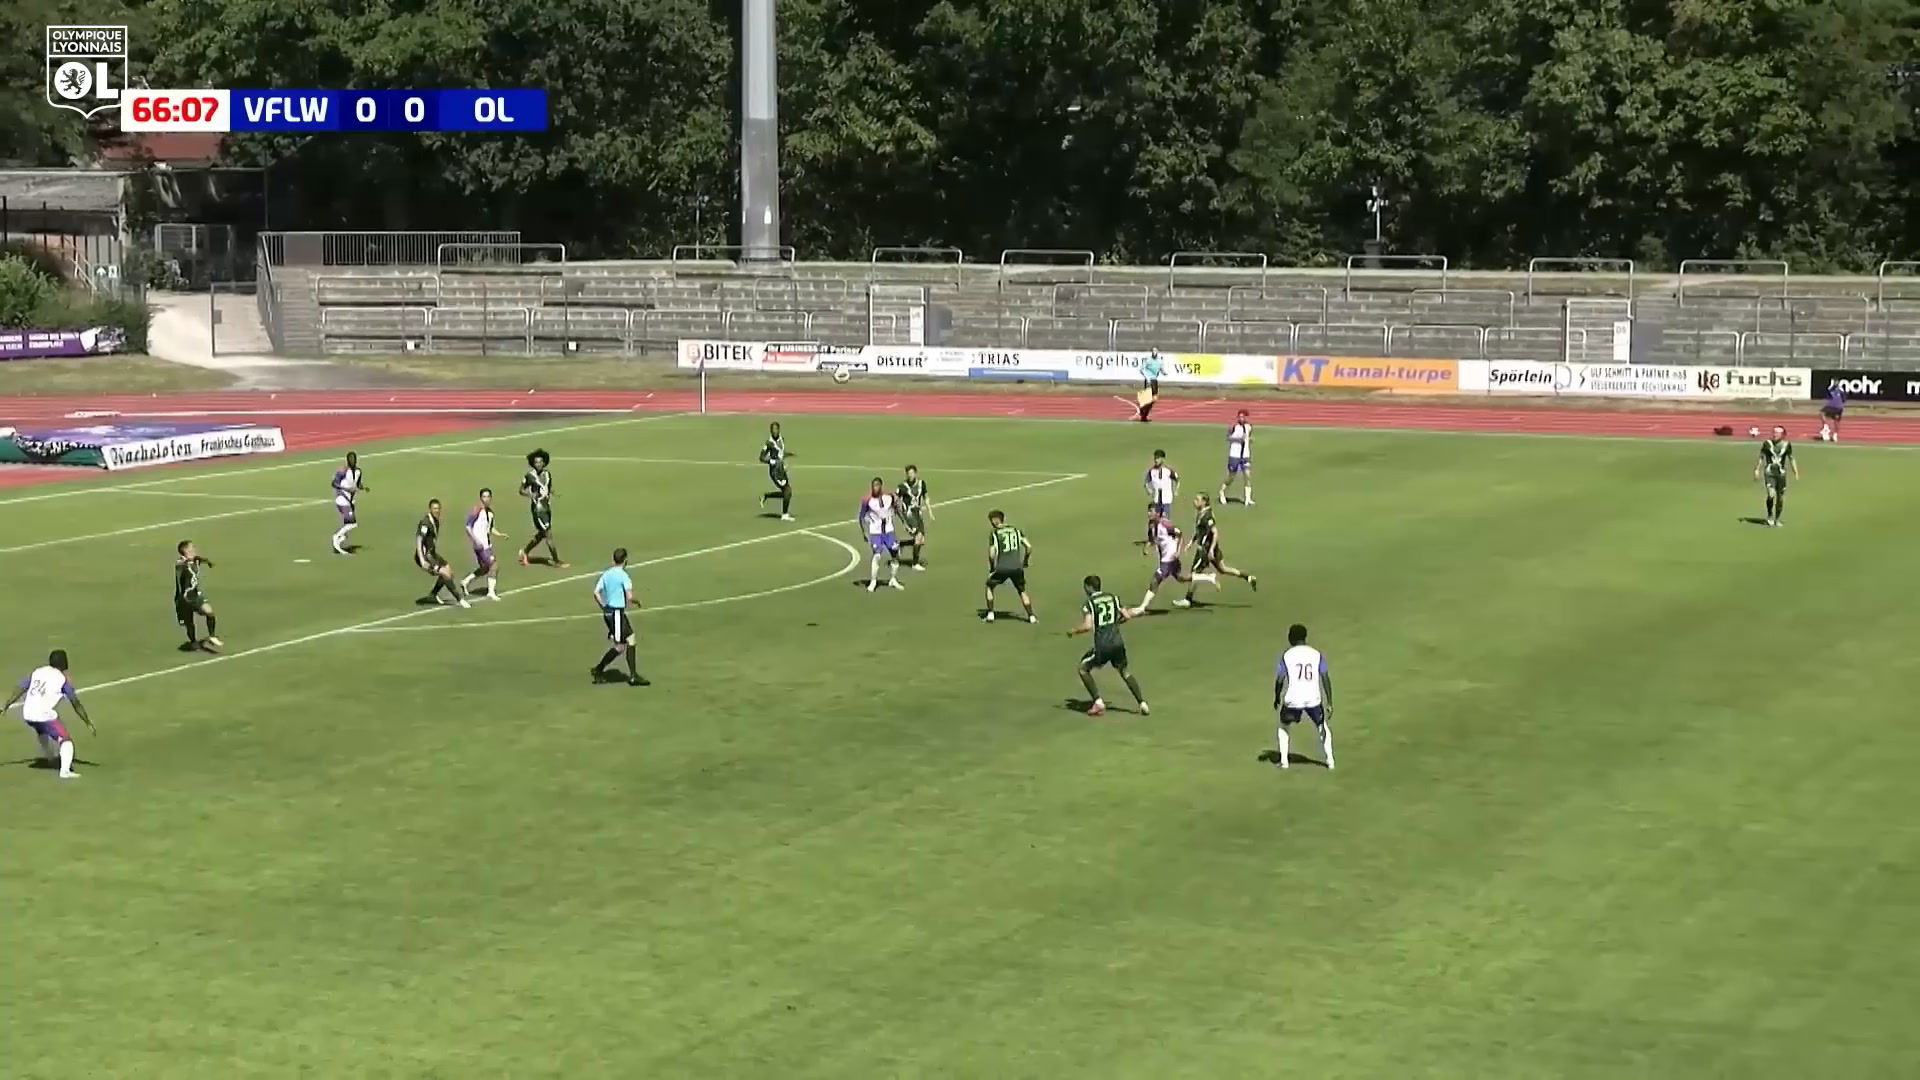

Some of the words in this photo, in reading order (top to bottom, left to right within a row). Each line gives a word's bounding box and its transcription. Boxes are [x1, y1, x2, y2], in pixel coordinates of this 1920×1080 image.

[704, 343, 753, 361] BITEK
[978, 351, 1021, 367] TRIAS
[877, 355, 923, 368] DISTLER
[1282, 357, 1330, 383] KT
[1333, 363, 1453, 384] kanal-turpe
[1489, 368, 1553, 386] Spörlein
[1604, 367, 1632, 379] SCHMITT
[1641, 368, 1670, 380] PARTNER
[1726, 369, 1802, 386] fuchs
[1098, 602, 1115, 626] 23
[30, 679, 47, 698] 24
